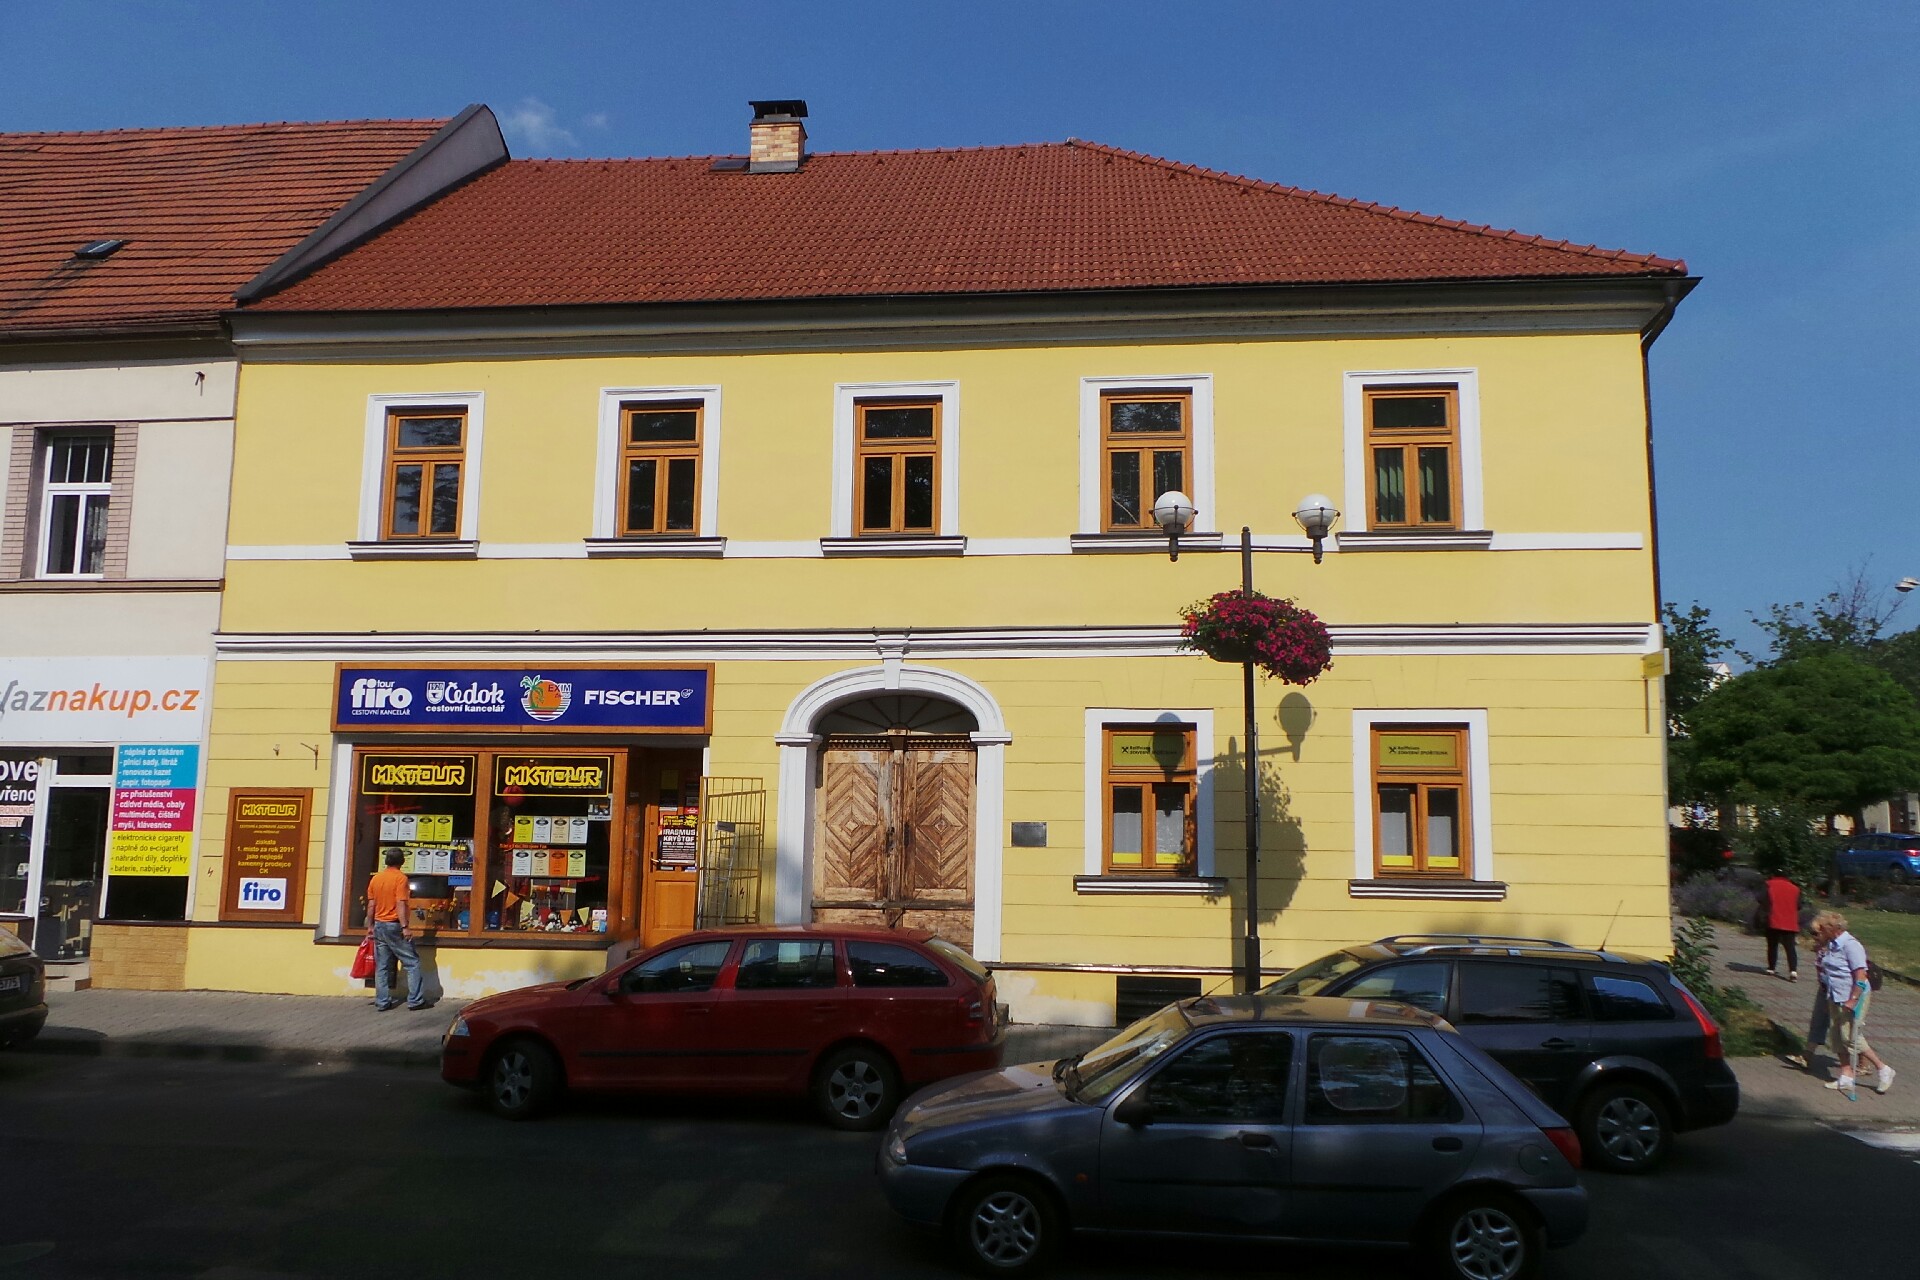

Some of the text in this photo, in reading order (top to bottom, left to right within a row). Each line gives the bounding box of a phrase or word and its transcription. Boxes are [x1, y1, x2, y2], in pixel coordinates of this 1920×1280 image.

[351, 679, 412, 708] firo
[445, 682, 505, 704] Čedok
[548, 684, 572, 692] EXIM
[584, 690, 681, 706] FISCHER
[465, 704, 505, 712] kancelář
[372, 765, 465, 785] MKTOUR
[505, 766, 600, 786] MKTOUR
[130, 790, 172, 799] příslušenství
[167, 801, 185, 810] obaly
[242, 804, 296, 816] MKTOUR
[150, 845, 179, 853] e-cigaret
[243, 882, 281, 901] firo
